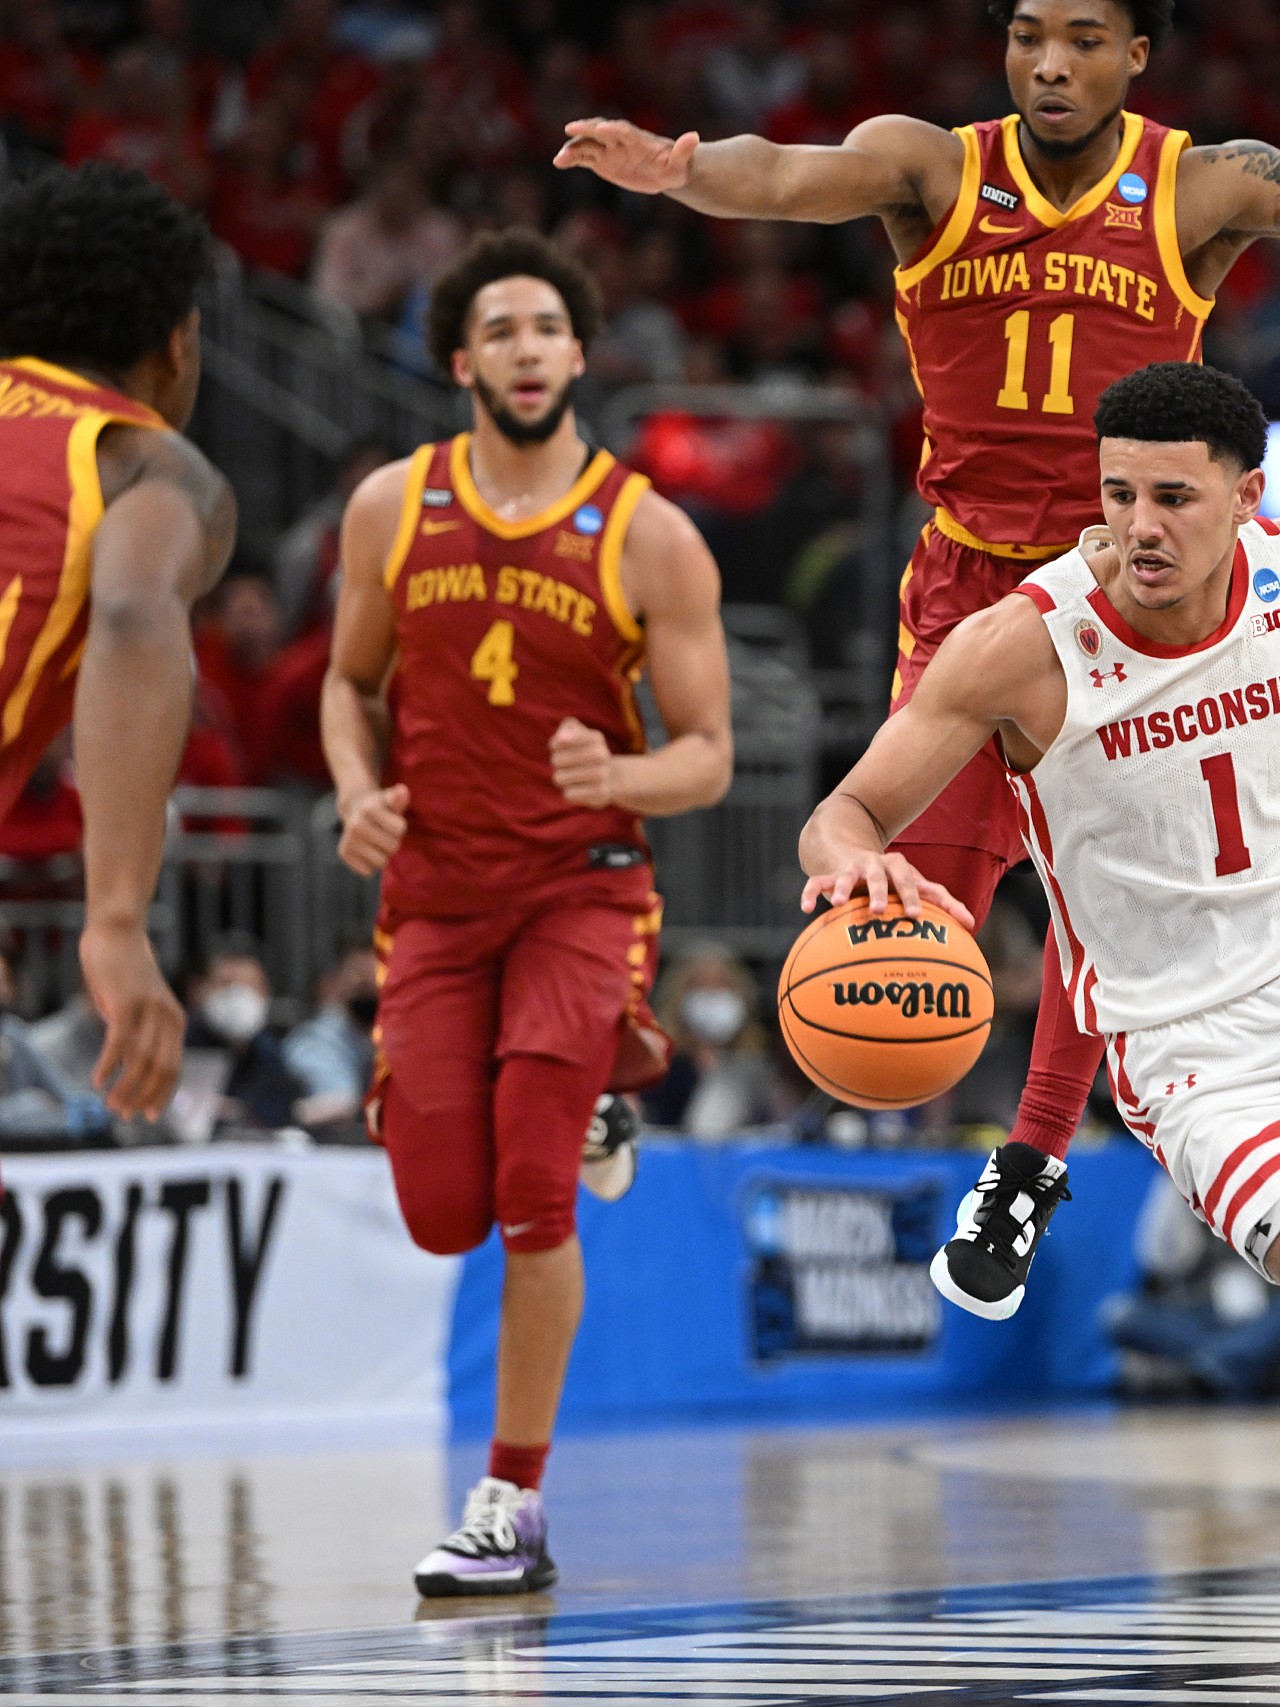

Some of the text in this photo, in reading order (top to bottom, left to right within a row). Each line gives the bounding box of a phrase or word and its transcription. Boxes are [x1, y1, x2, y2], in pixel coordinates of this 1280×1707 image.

[981, 184, 1018, 209] UNITY
[940, 252, 1158, 321] IOWA STATE
[996, 310, 1075, 414] 11
[407, 563, 598, 636] IOWA STATE
[1258, 581, 1280, 596] NCAA
[470, 618, 519, 706] 4
[1200, 752, 1252, 877] 1
[847, 916, 948, 947] NCAA
[832, 981, 972, 1019] Wilson
